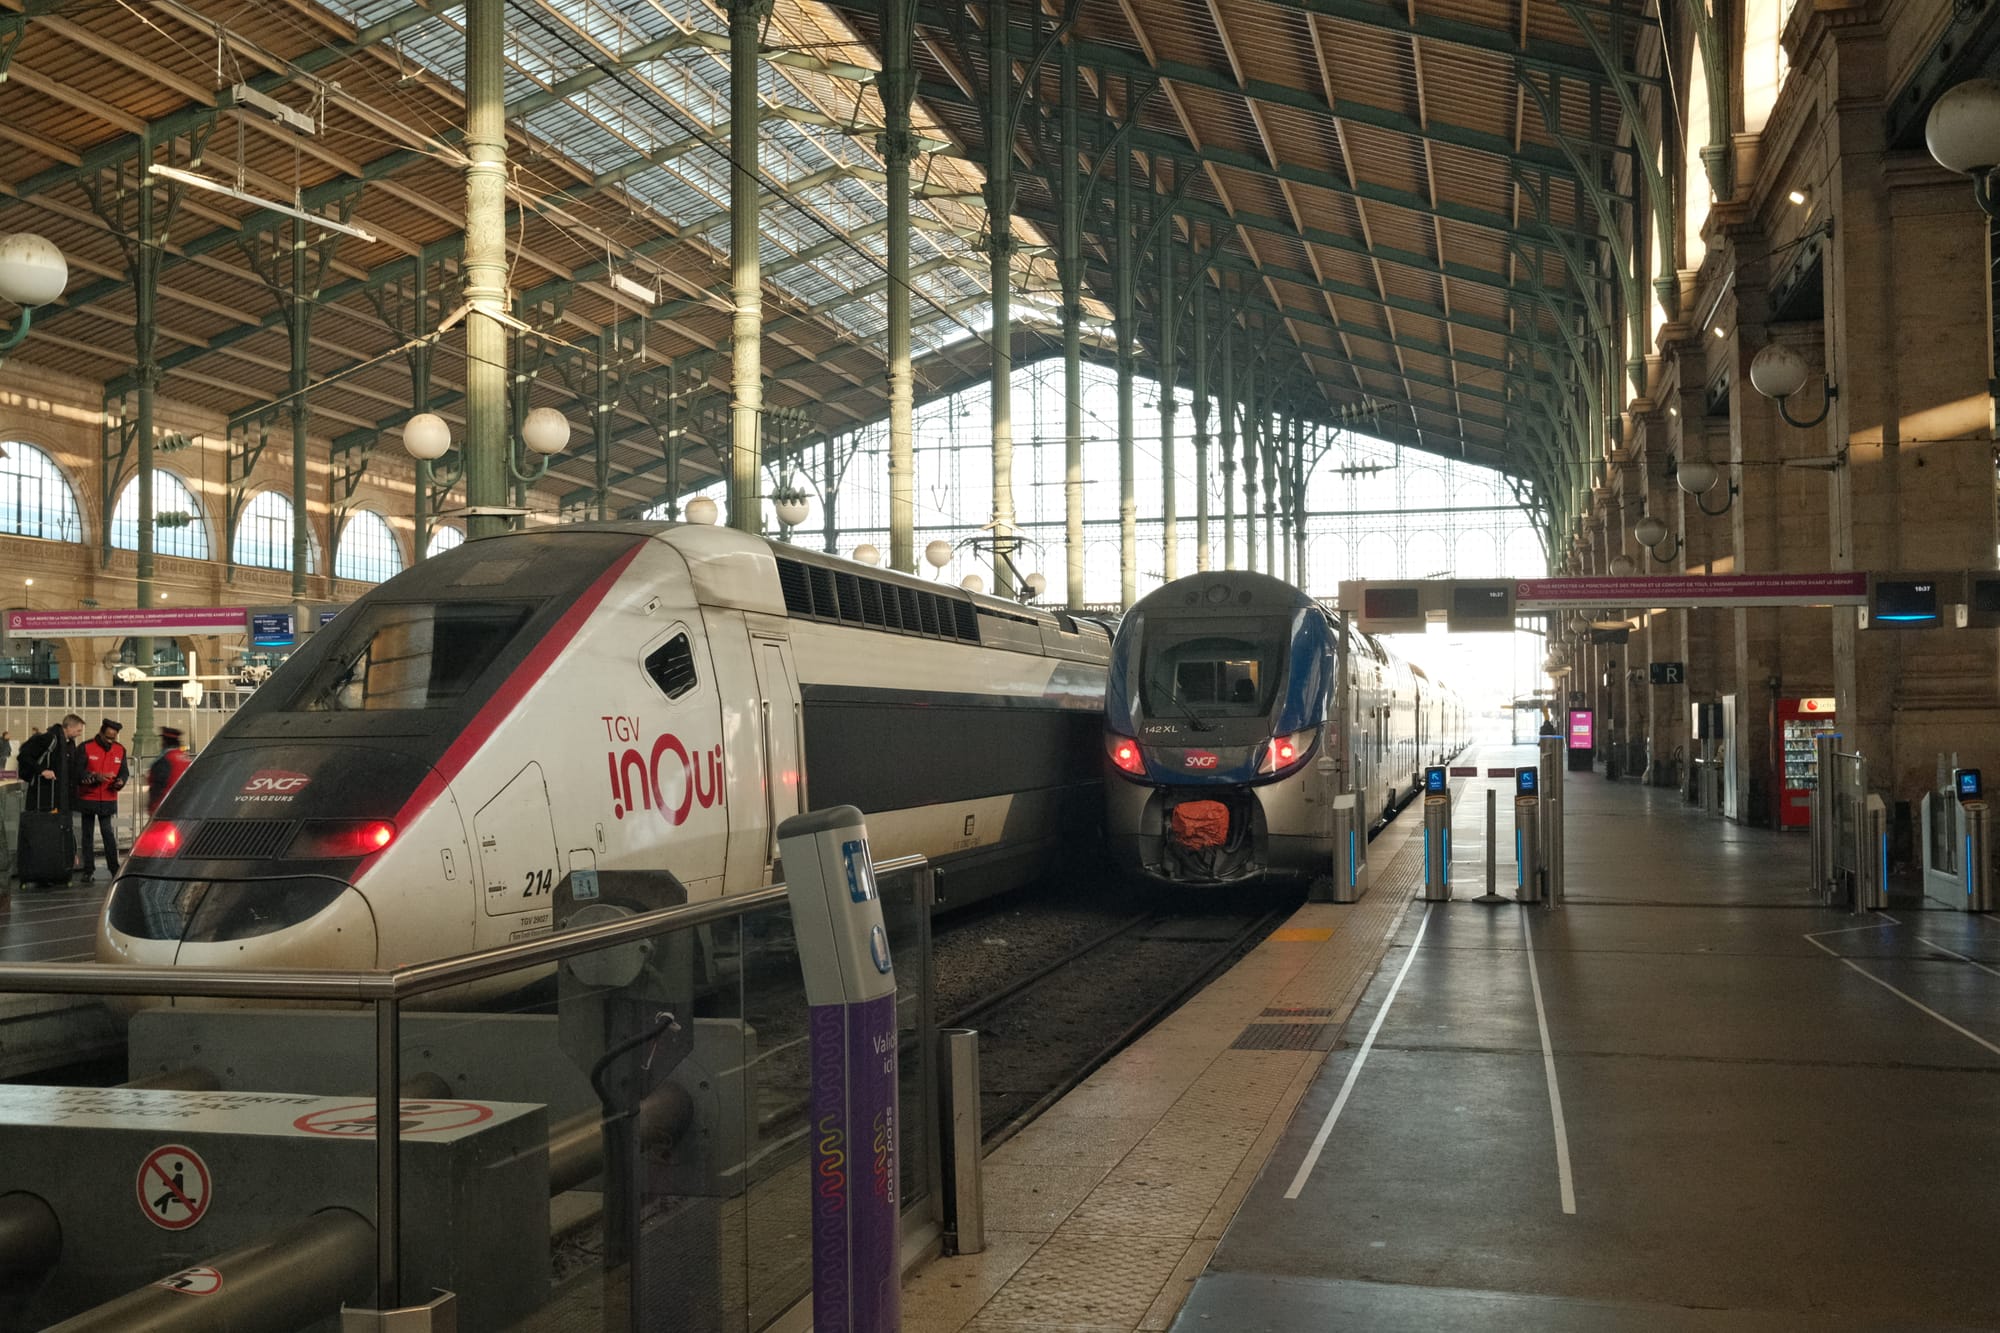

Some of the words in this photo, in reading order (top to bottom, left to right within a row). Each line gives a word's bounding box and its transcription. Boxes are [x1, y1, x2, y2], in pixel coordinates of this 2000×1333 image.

[1667, 668, 1678, 682] R
[602, 716, 640, 742] TGV
[1185, 756, 1217, 767] SNCF
[246, 778, 308, 791] SNCF
[523, 869, 552, 897] 214
[520, 917, 532, 926] TGV
